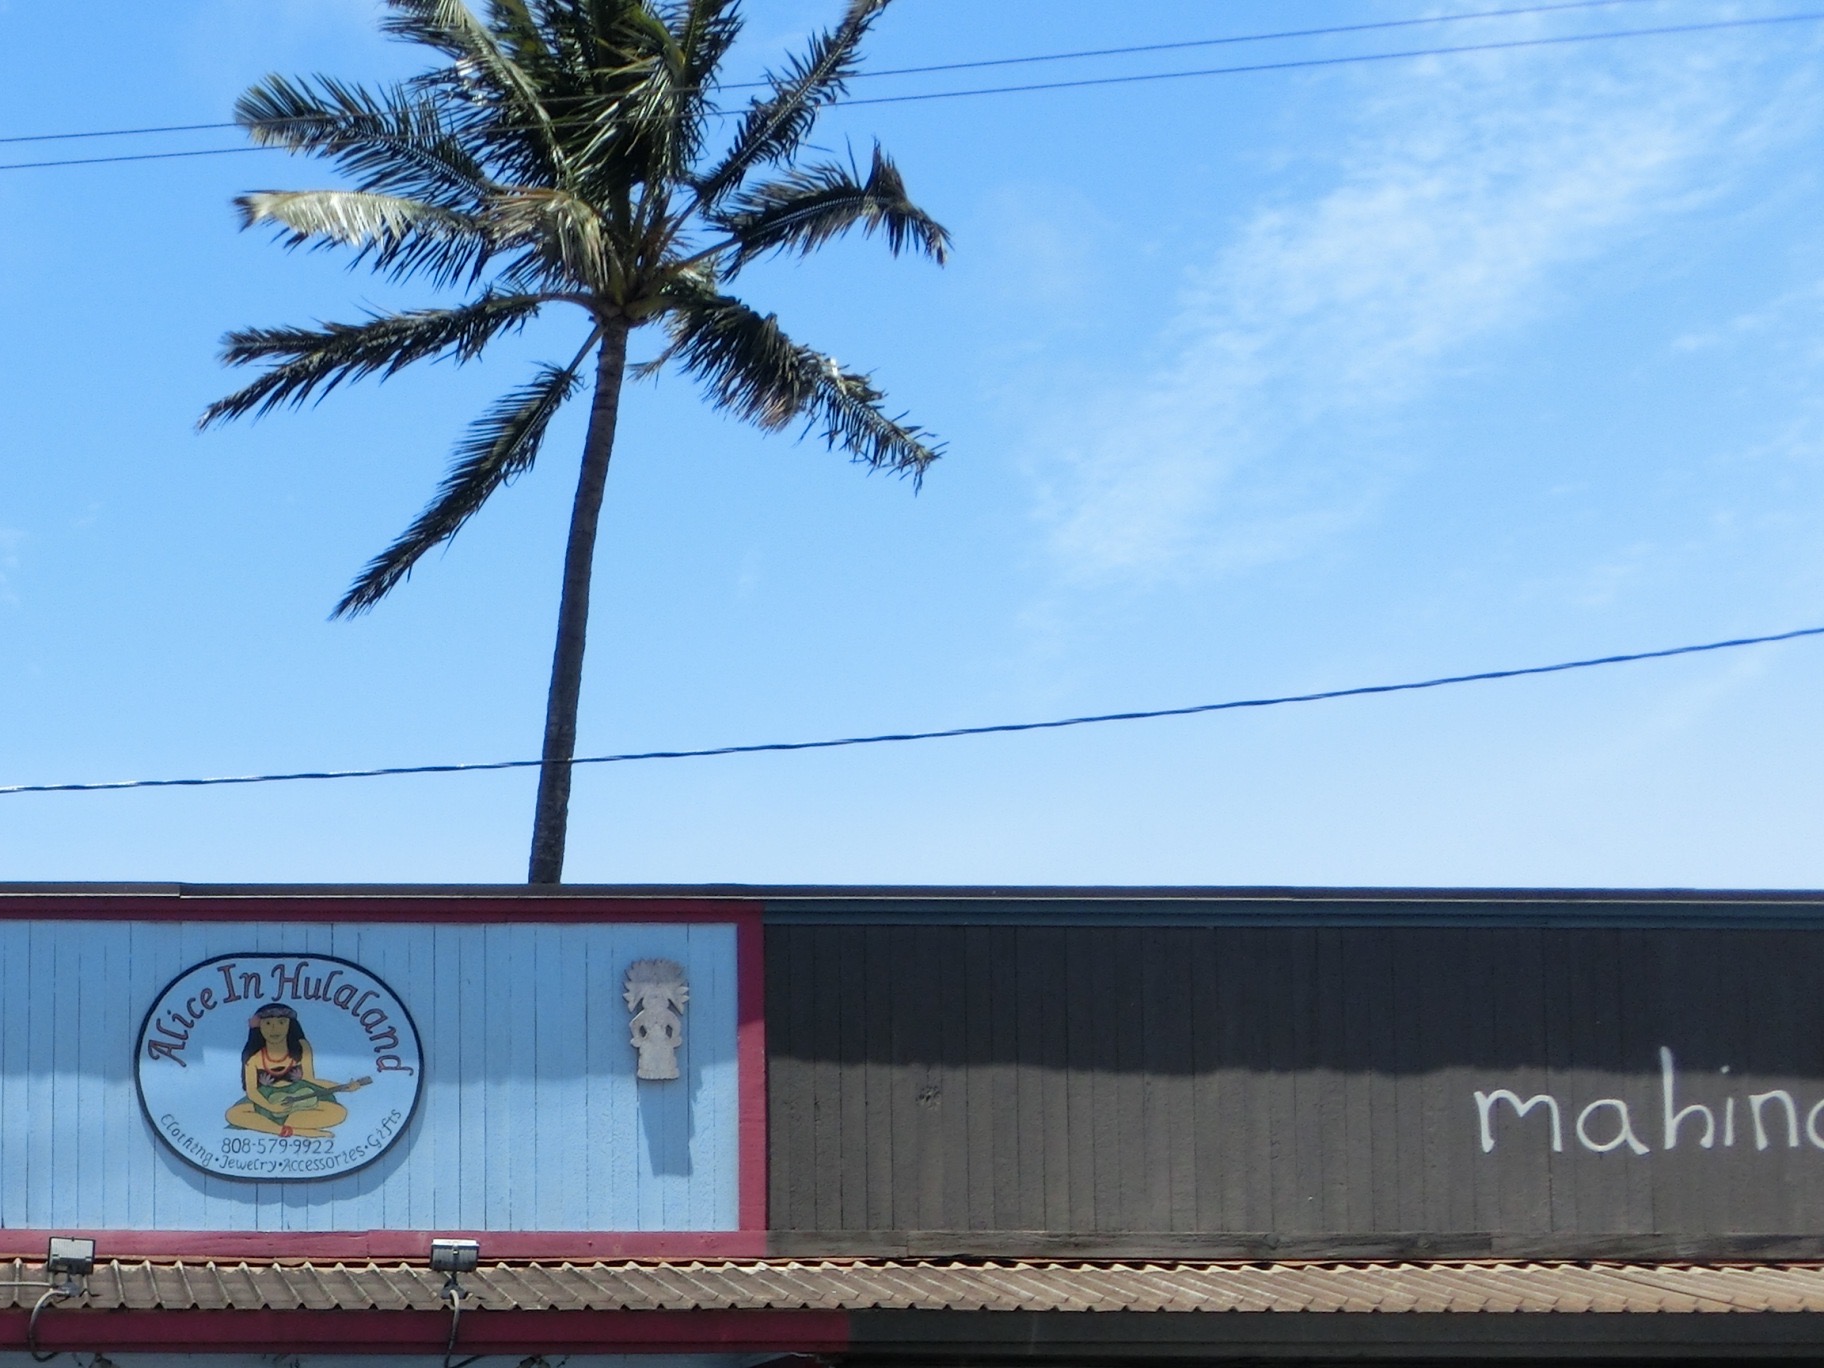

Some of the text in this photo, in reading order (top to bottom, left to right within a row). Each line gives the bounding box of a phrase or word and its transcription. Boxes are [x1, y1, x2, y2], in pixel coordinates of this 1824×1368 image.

[147, 961, 415, 1076] Alice In Hulaland
[160, 1108, 402, 1173] Clothing Jewelry Accessories Gifts
[1473, 1045, 1824, 1154] mahin
[221, 1137, 335, 1155] 808-579-9922
